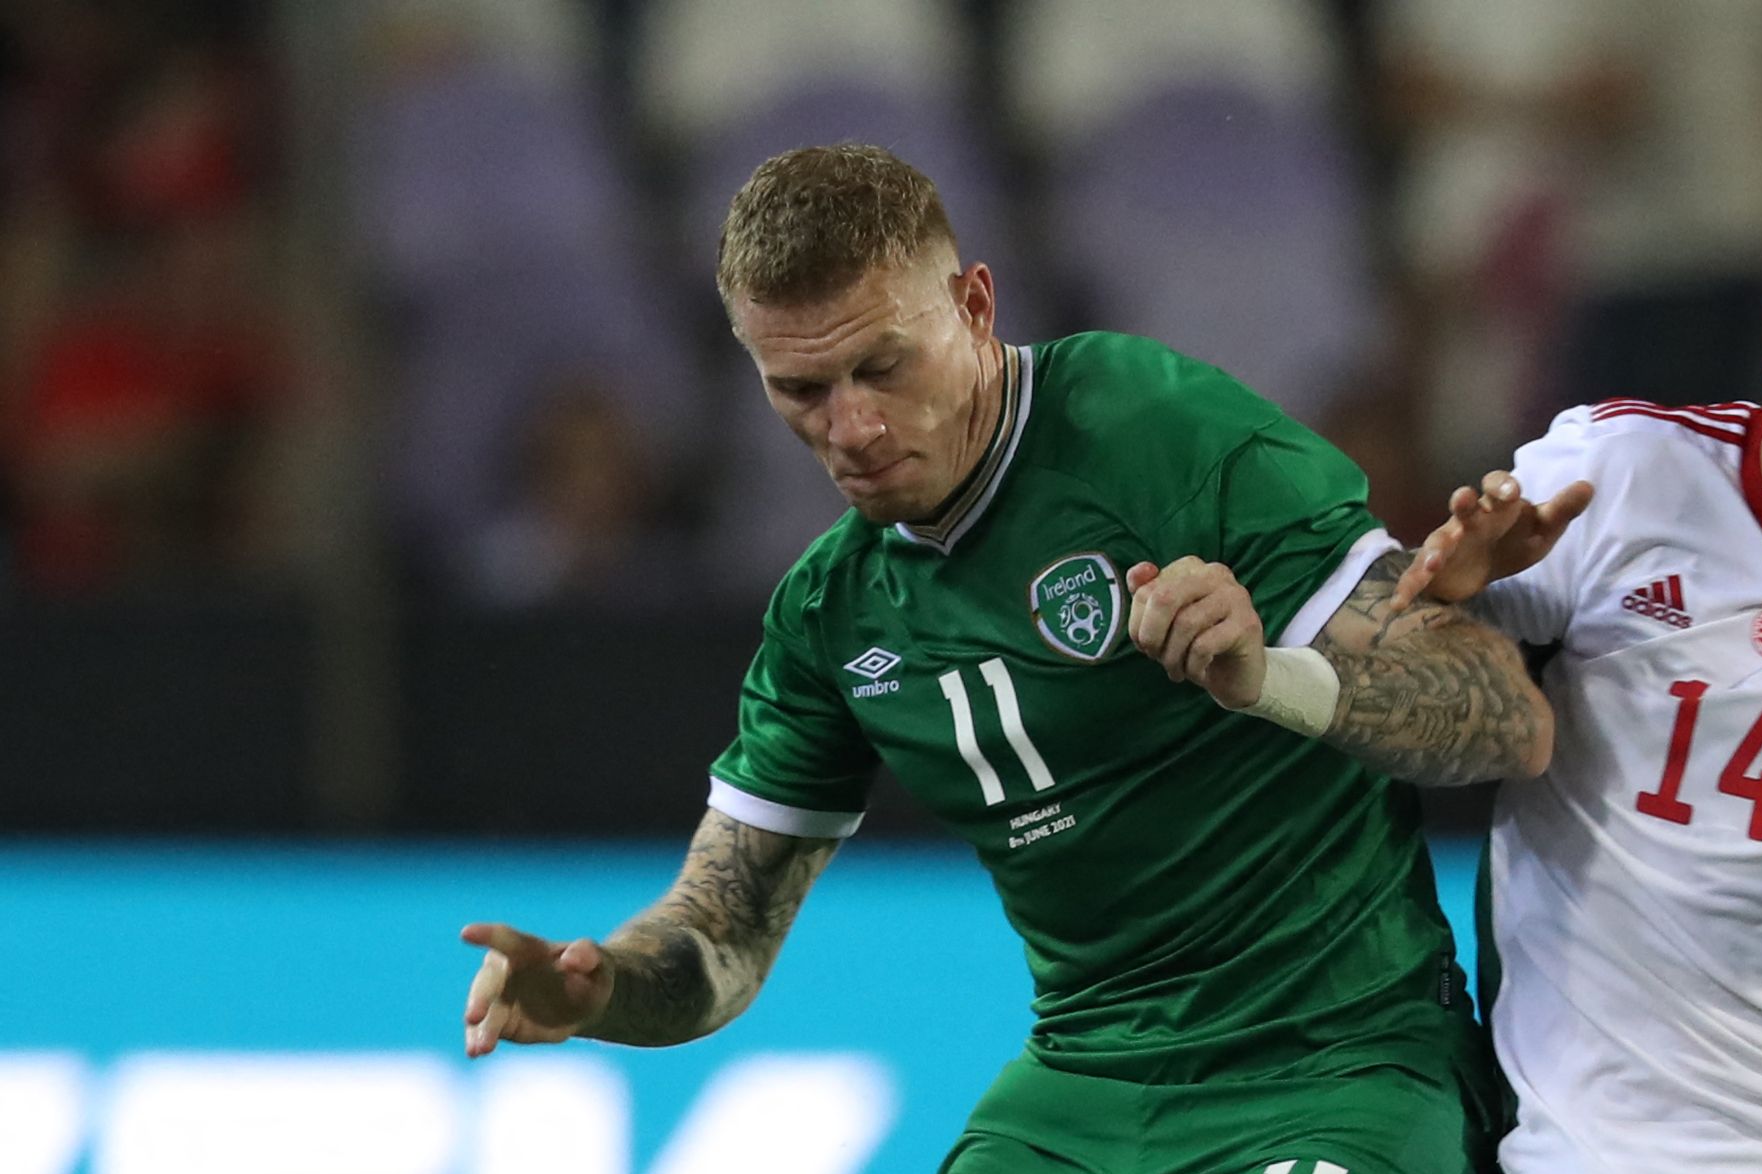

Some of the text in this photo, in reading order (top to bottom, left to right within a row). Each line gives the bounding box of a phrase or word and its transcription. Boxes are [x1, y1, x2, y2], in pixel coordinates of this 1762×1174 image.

[1042, 564, 1096, 600] Ireland
[1622, 595, 1692, 629] adidas
[852, 680, 899, 698] umbro
[938, 657, 1055, 806] 11
[1010, 801, 1061, 830] HUNGARY
[1024, 825, 1051, 845] JUNE
[1050, 815, 1077, 833] 2021
